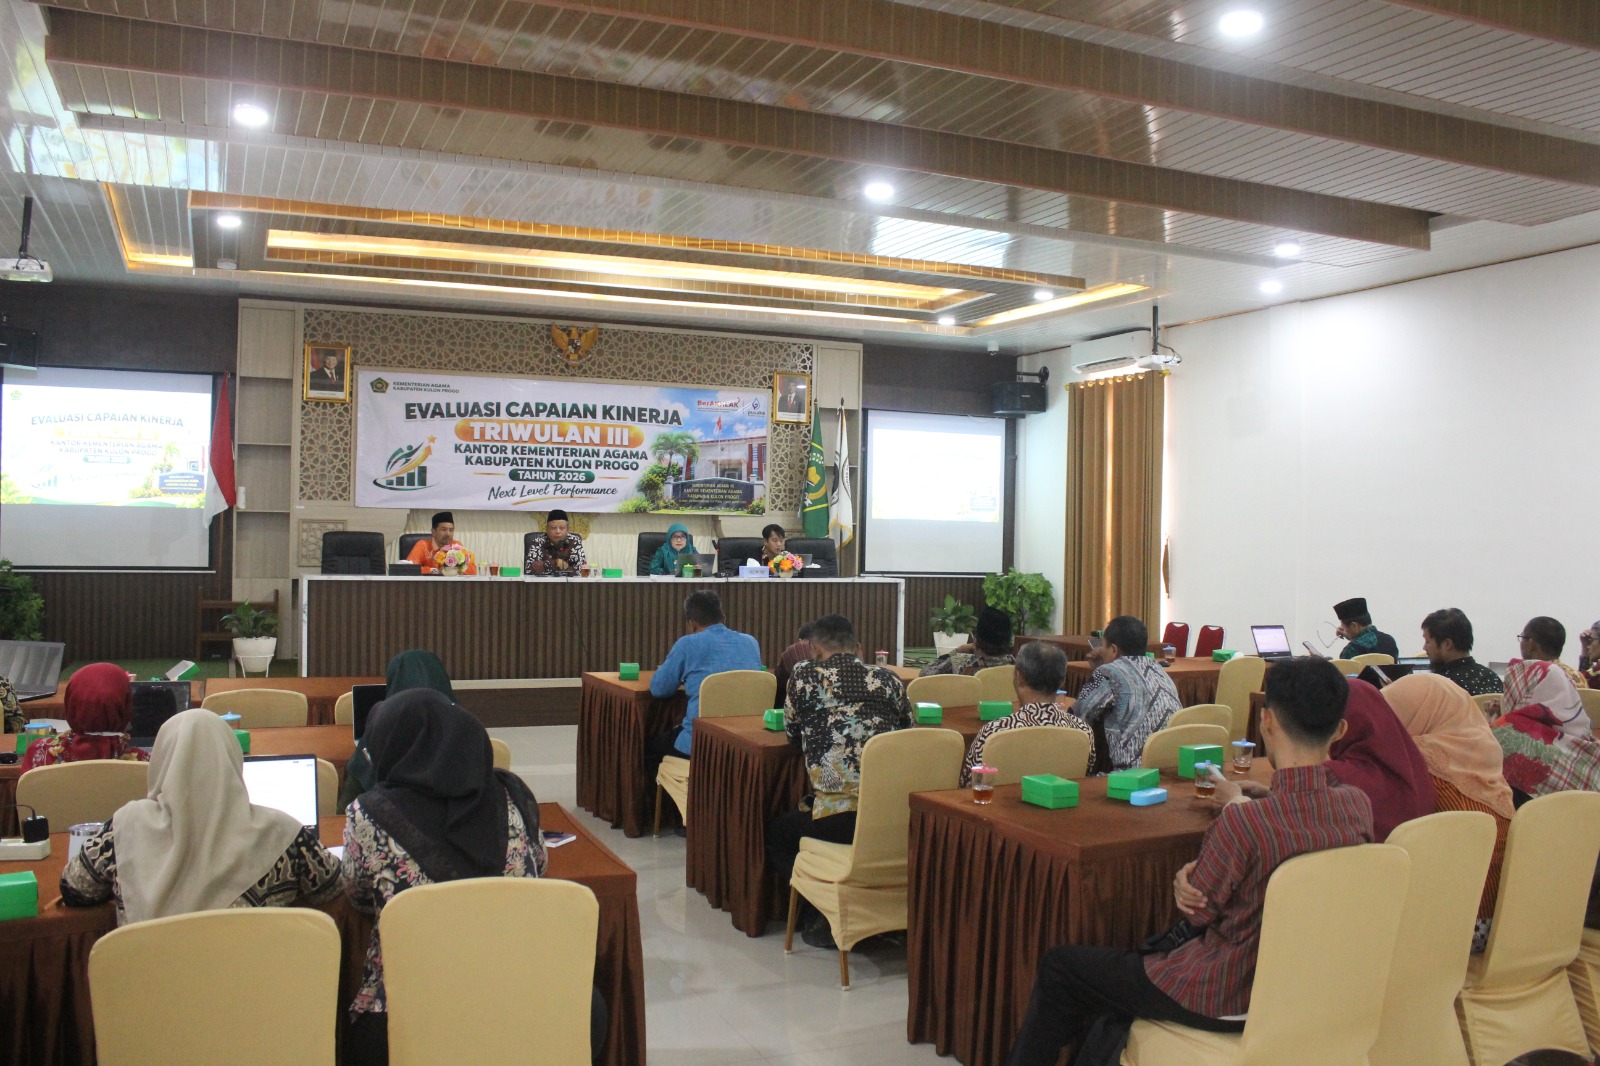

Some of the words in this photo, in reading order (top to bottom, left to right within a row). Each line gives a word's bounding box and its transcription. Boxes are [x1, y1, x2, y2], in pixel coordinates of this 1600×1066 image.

[31, 413, 84, 426] EVALUASI
[87, 412, 138, 422] CAPAIAN
[140, 413, 184, 427] KINERJA
[405, 402, 500, 419] EVALUASI
[505, 402, 597, 419] CAPAIAN
[602, 405, 682, 426] KINERJA
[469, 422, 601, 445] TRIWULAN
[606, 427, 629, 446] III
[454, 444, 508, 455] KANTOR
[511, 446, 600, 459] KEMENTERIAN
[603, 449, 648, 460] AGAMA
[465, 456, 543, 468] KABUPATEN
[546, 458, 592, 470] KULON
[595, 460, 639, 471] PROGO
[517, 471, 556, 480] TAHUN
[558, 472, 586, 481] 2026
[487, 486, 517, 501] Next
[519, 484, 549, 498] Level
[553, 484, 618, 498] Performance
